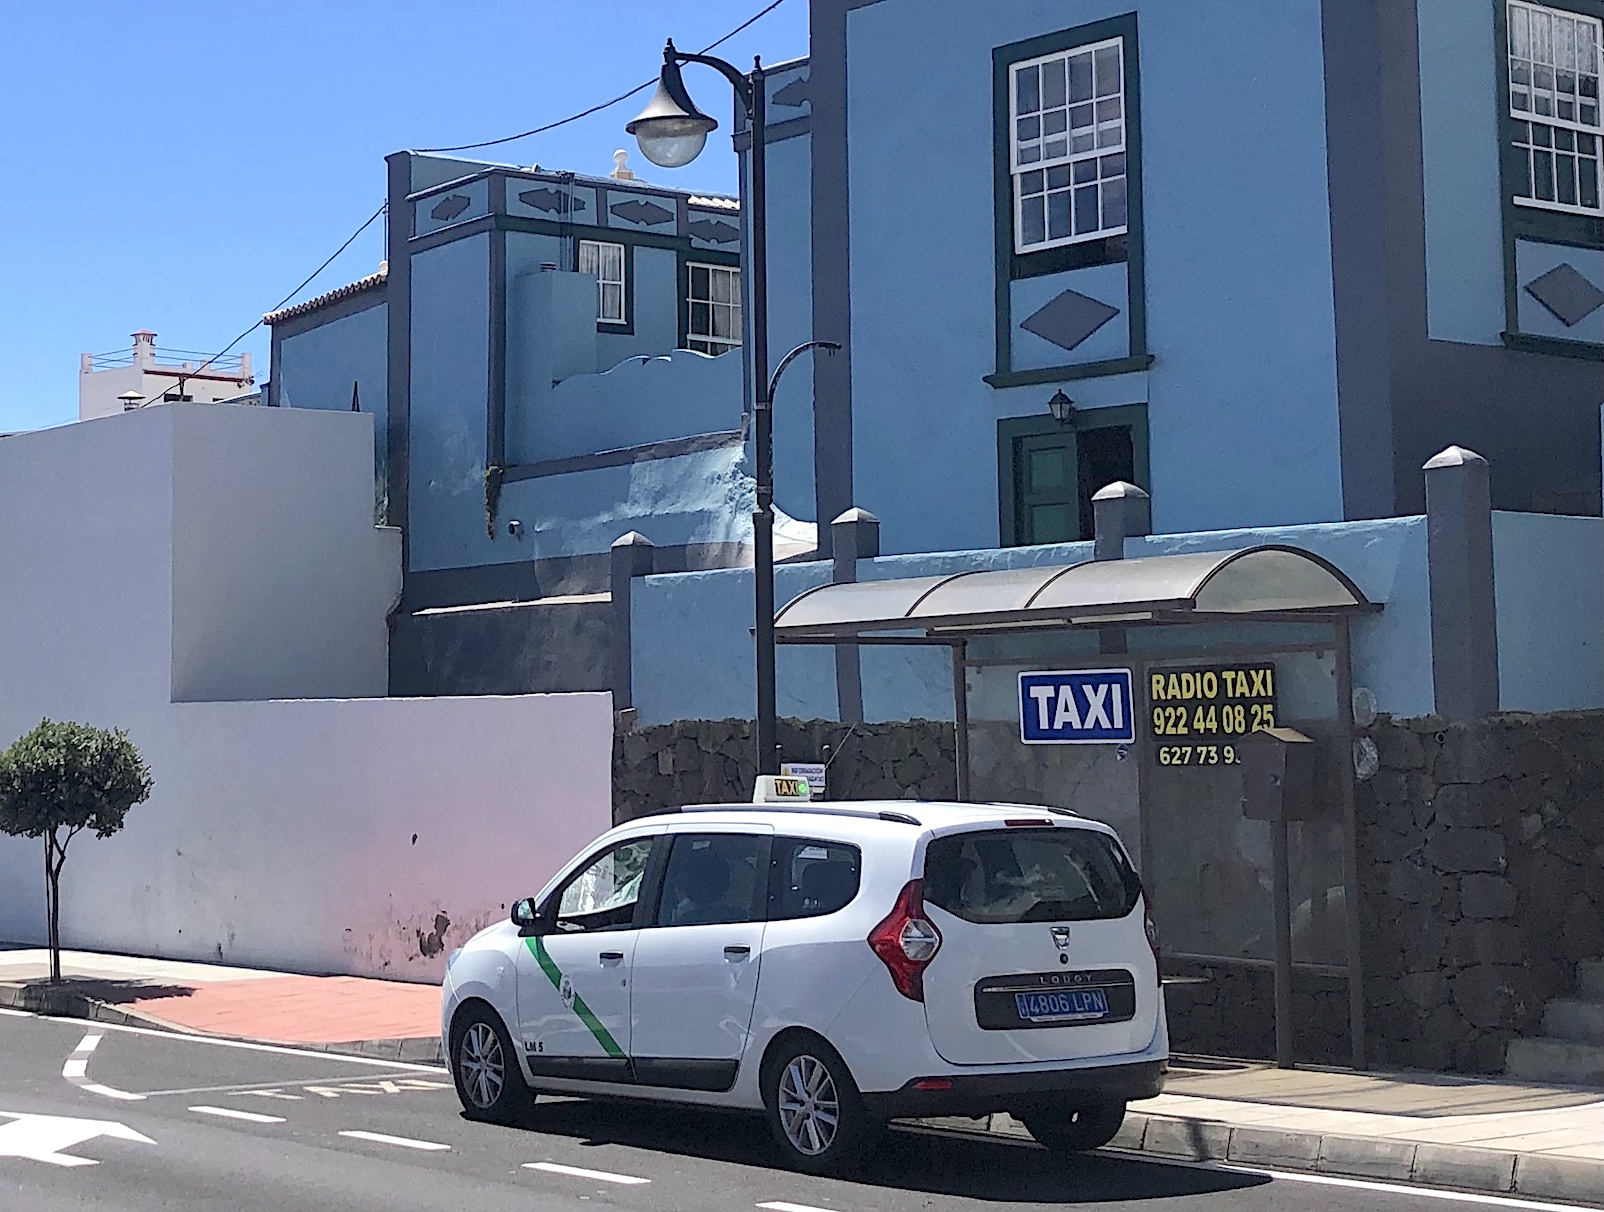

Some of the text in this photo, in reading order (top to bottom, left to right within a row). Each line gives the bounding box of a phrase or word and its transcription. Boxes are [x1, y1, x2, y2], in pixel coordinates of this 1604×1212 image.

[1151, 669, 1274, 700] RADIO TAXI
[1029, 683, 1124, 730] TAXI
[1153, 703, 1275, 735] 922 44 08 25
[1159, 745, 1242, 765] 627 73 9
[775, 780, 798, 795] TAXI
[1039, 974, 1093, 984] LODGY
[1029, 994, 1070, 1014] 4806
[538, 1041, 544, 1052] 5
